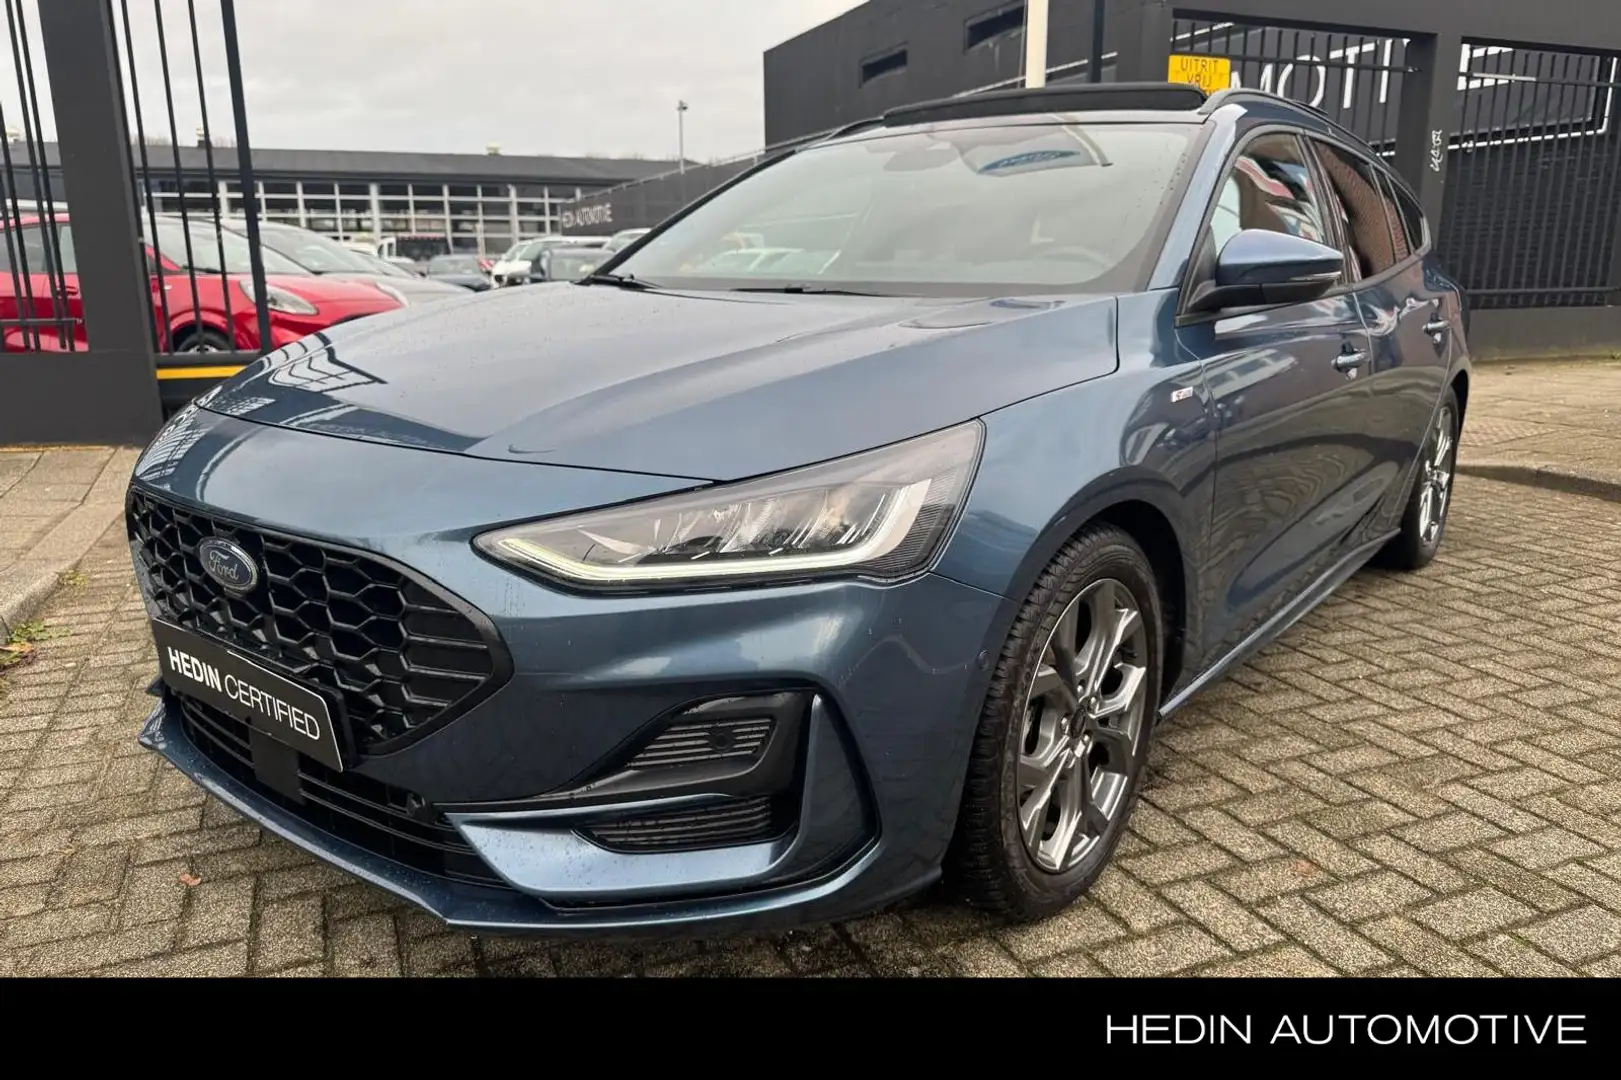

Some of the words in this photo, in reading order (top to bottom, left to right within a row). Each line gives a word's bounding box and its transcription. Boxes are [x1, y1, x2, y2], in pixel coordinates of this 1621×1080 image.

[1180, 57, 1219, 74] UITRIT
[209, 550, 240, 581] Ford
[167, 646, 222, 692] HEDIN
[224, 674, 320, 740] CERTIFIED
